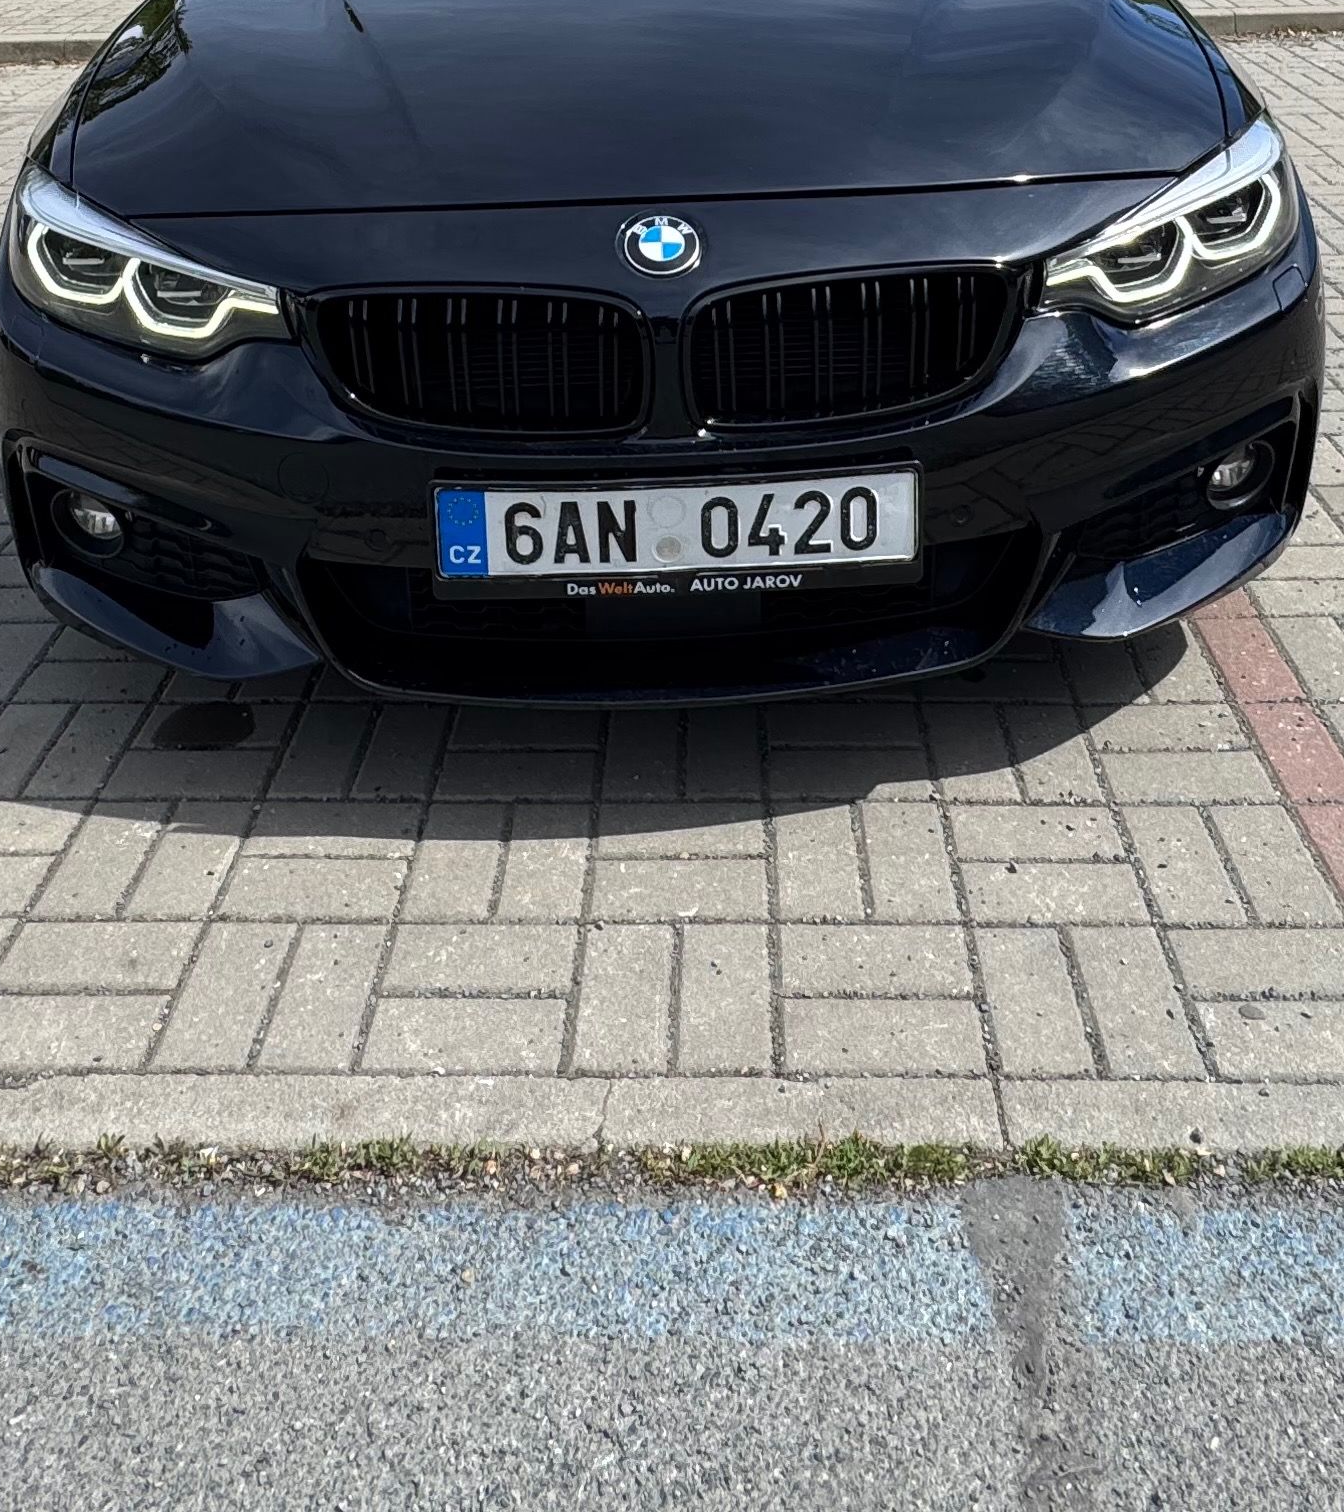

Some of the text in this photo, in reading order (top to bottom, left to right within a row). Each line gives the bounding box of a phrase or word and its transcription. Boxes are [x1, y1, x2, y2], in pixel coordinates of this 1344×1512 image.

[504, 486, 879, 565] 6AN 0420
[449, 545, 481, 565] CZ
[566, 583, 596, 596] Das
[690, 574, 803, 592] AUTO JAROV
